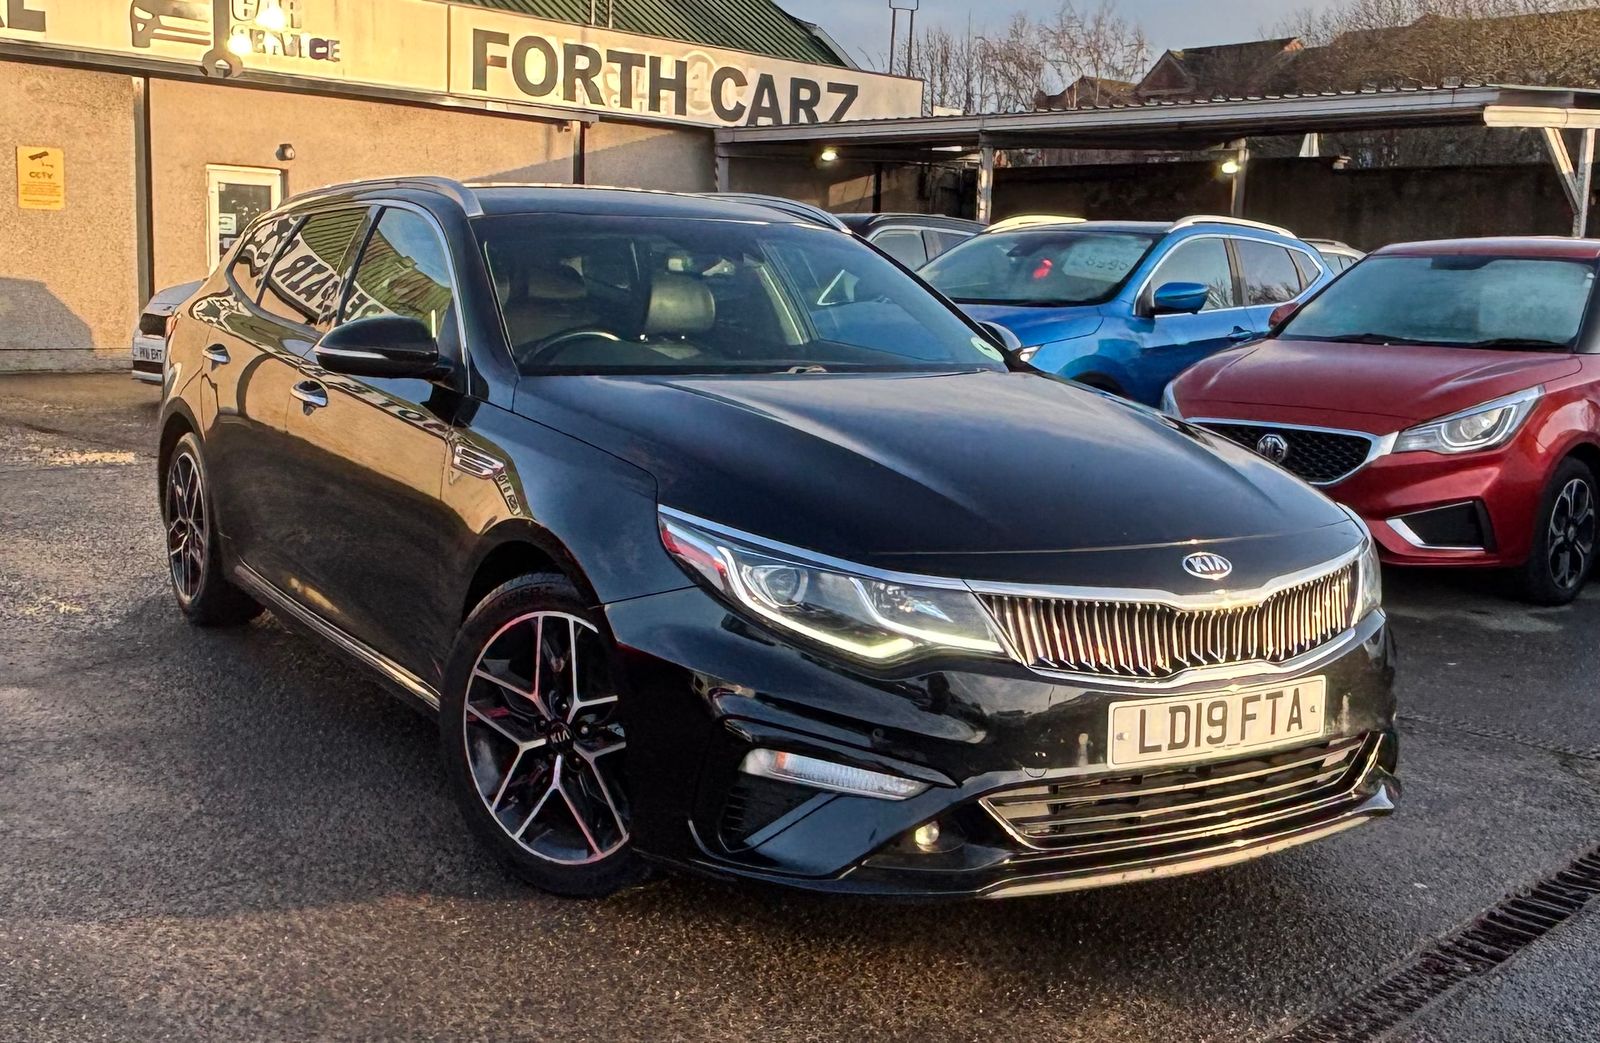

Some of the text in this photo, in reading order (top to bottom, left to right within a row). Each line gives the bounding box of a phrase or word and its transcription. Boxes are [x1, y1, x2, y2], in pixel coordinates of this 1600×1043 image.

[231, 0, 302, 29] CR
[472, 28, 859, 127] FORTH CARZ
[29, 171, 53, 179] CCTV
[1188, 555, 1229, 573] KIA
[1138, 687, 1303, 754] LD19 FTA
[549, 729, 571, 744] KIA
